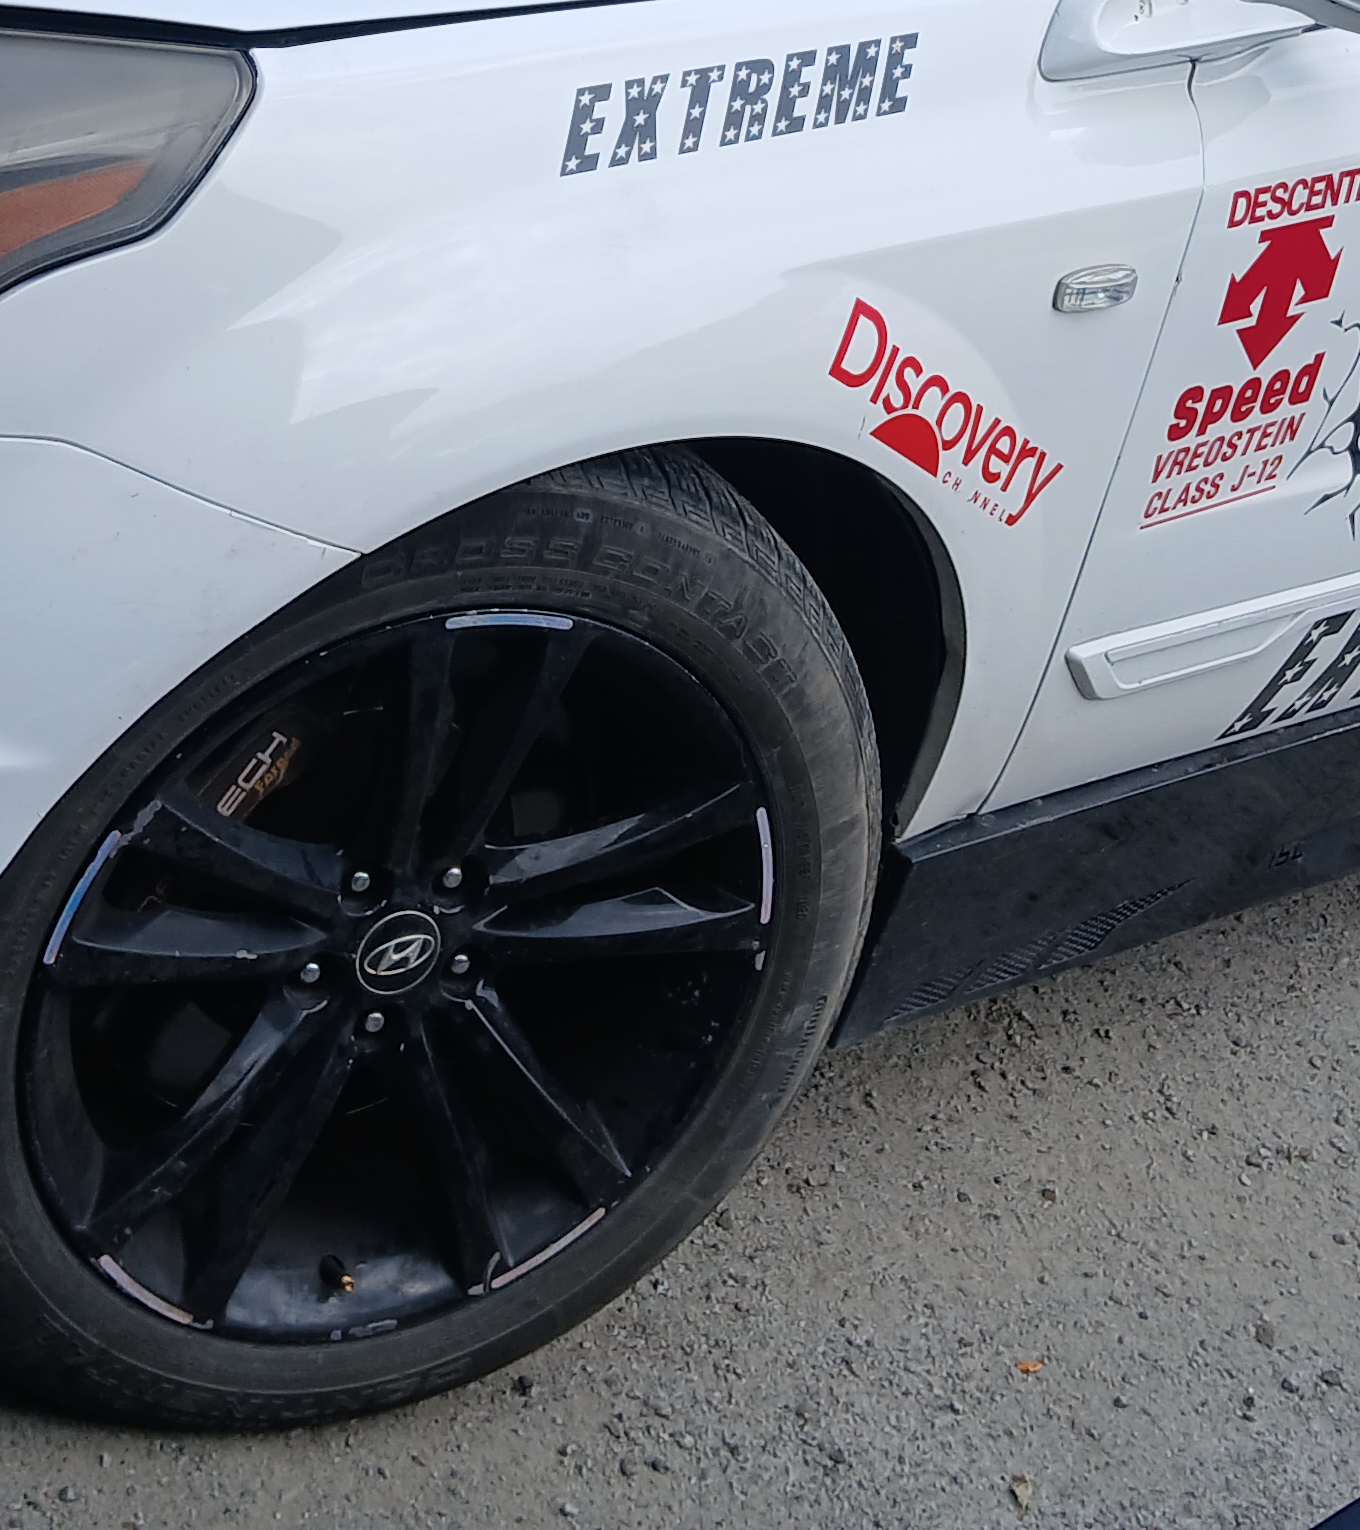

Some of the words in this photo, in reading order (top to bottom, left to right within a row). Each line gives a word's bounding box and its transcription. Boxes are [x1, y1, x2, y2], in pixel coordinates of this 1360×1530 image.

[560, 32, 919, 177] EXTREME
[1143, 472, 1225, 520] CLASS
[1231, 455, 1283, 492] J-12
